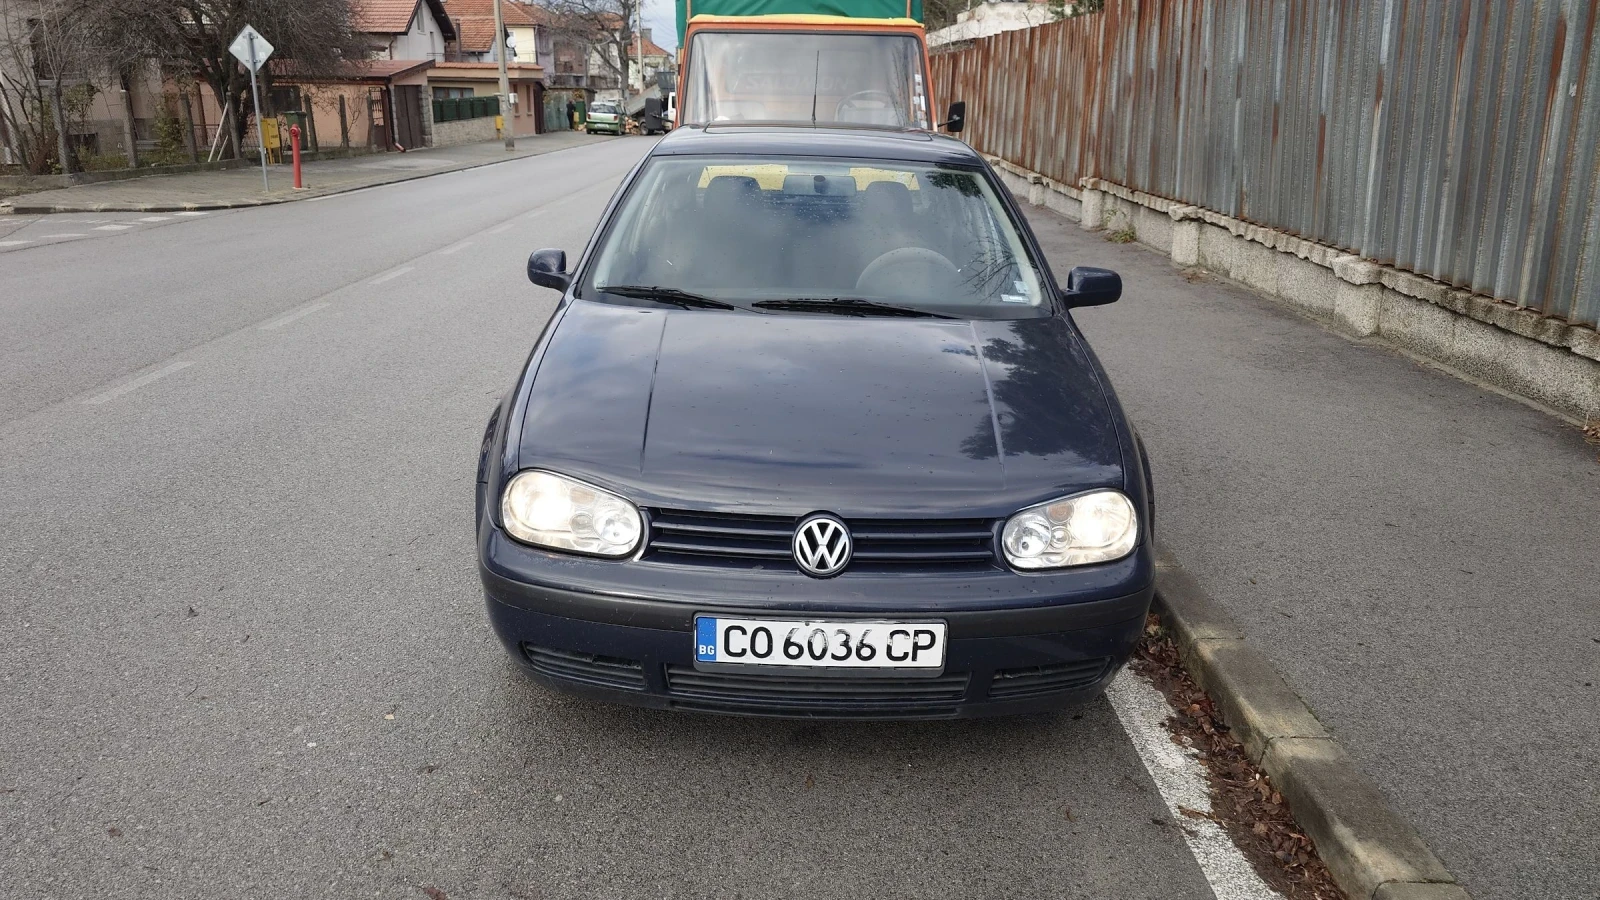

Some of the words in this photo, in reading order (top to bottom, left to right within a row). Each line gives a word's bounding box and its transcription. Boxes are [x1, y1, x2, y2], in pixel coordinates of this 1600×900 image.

[699, 644, 715, 655] BG
[723, 625, 773, 658] CO
[783, 627, 877, 661] 6036
[886, 629, 936, 661] CP
